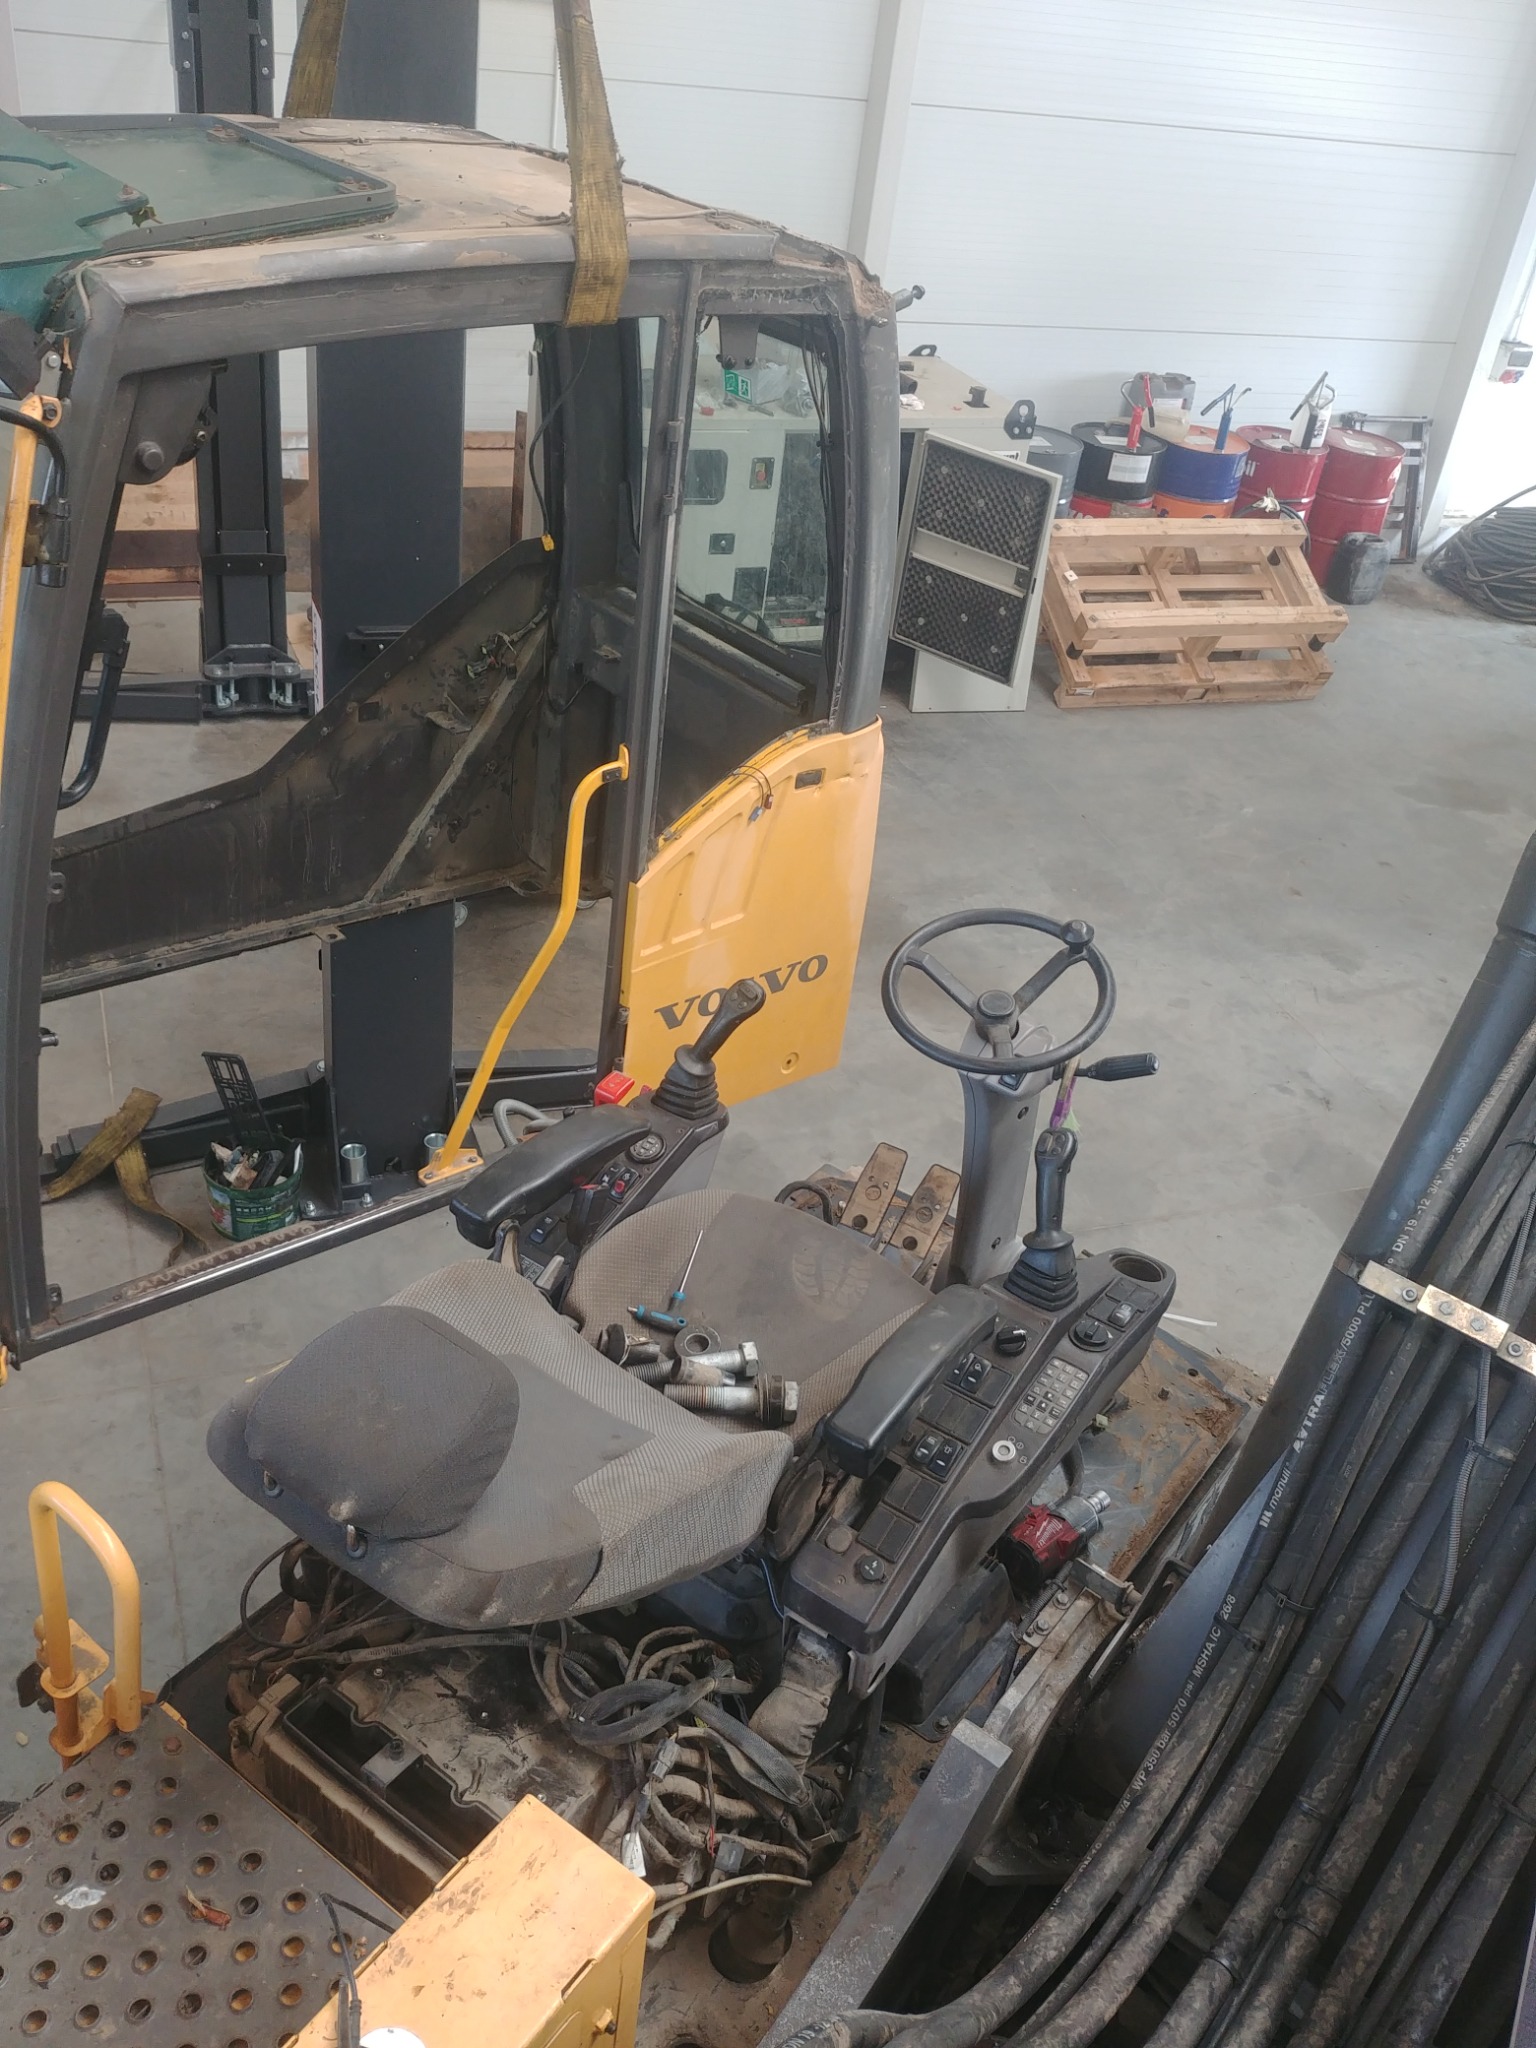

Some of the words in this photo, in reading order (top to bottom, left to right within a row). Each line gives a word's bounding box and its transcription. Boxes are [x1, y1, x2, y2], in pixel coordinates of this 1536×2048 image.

[654, 954, 829, 1030] VOVO
[1391, 1233, 1409, 1253] DN
[1405, 1218, 1418, 1233] 19
[1417, 1198, 1431, 1217] -12
[1440, 1154, 1458, 1177] WP
[1455, 1135, 1470, 1154] 350
[1132, 1769, 1147, 1792] WP
[1144, 1750, 1160, 1771] 350
[1157, 1729, 1172, 1750] bar
[1167, 1697, 1188, 1728] 5070
[1184, 1681, 1194, 1698] psi
[1192, 1642, 1216, 1679] MSHA
